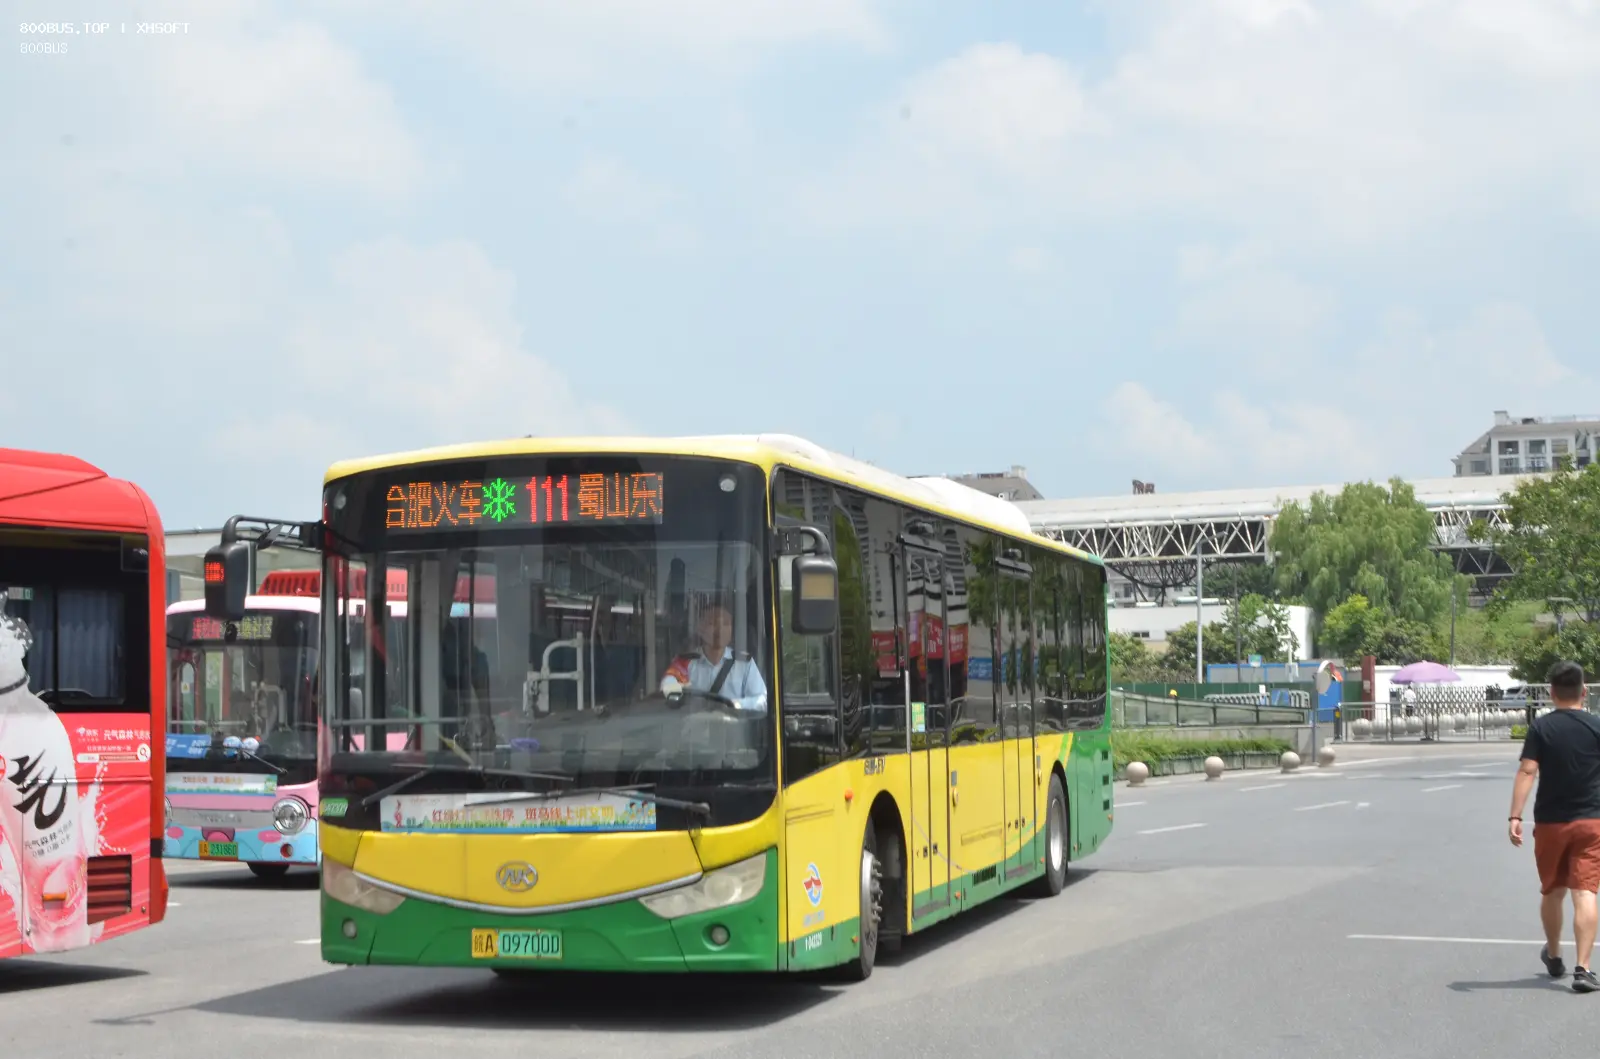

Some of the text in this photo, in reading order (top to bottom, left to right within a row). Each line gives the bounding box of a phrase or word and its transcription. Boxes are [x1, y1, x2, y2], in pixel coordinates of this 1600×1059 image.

[386, 472, 663, 528] 合肥火车 111 蜀山东
